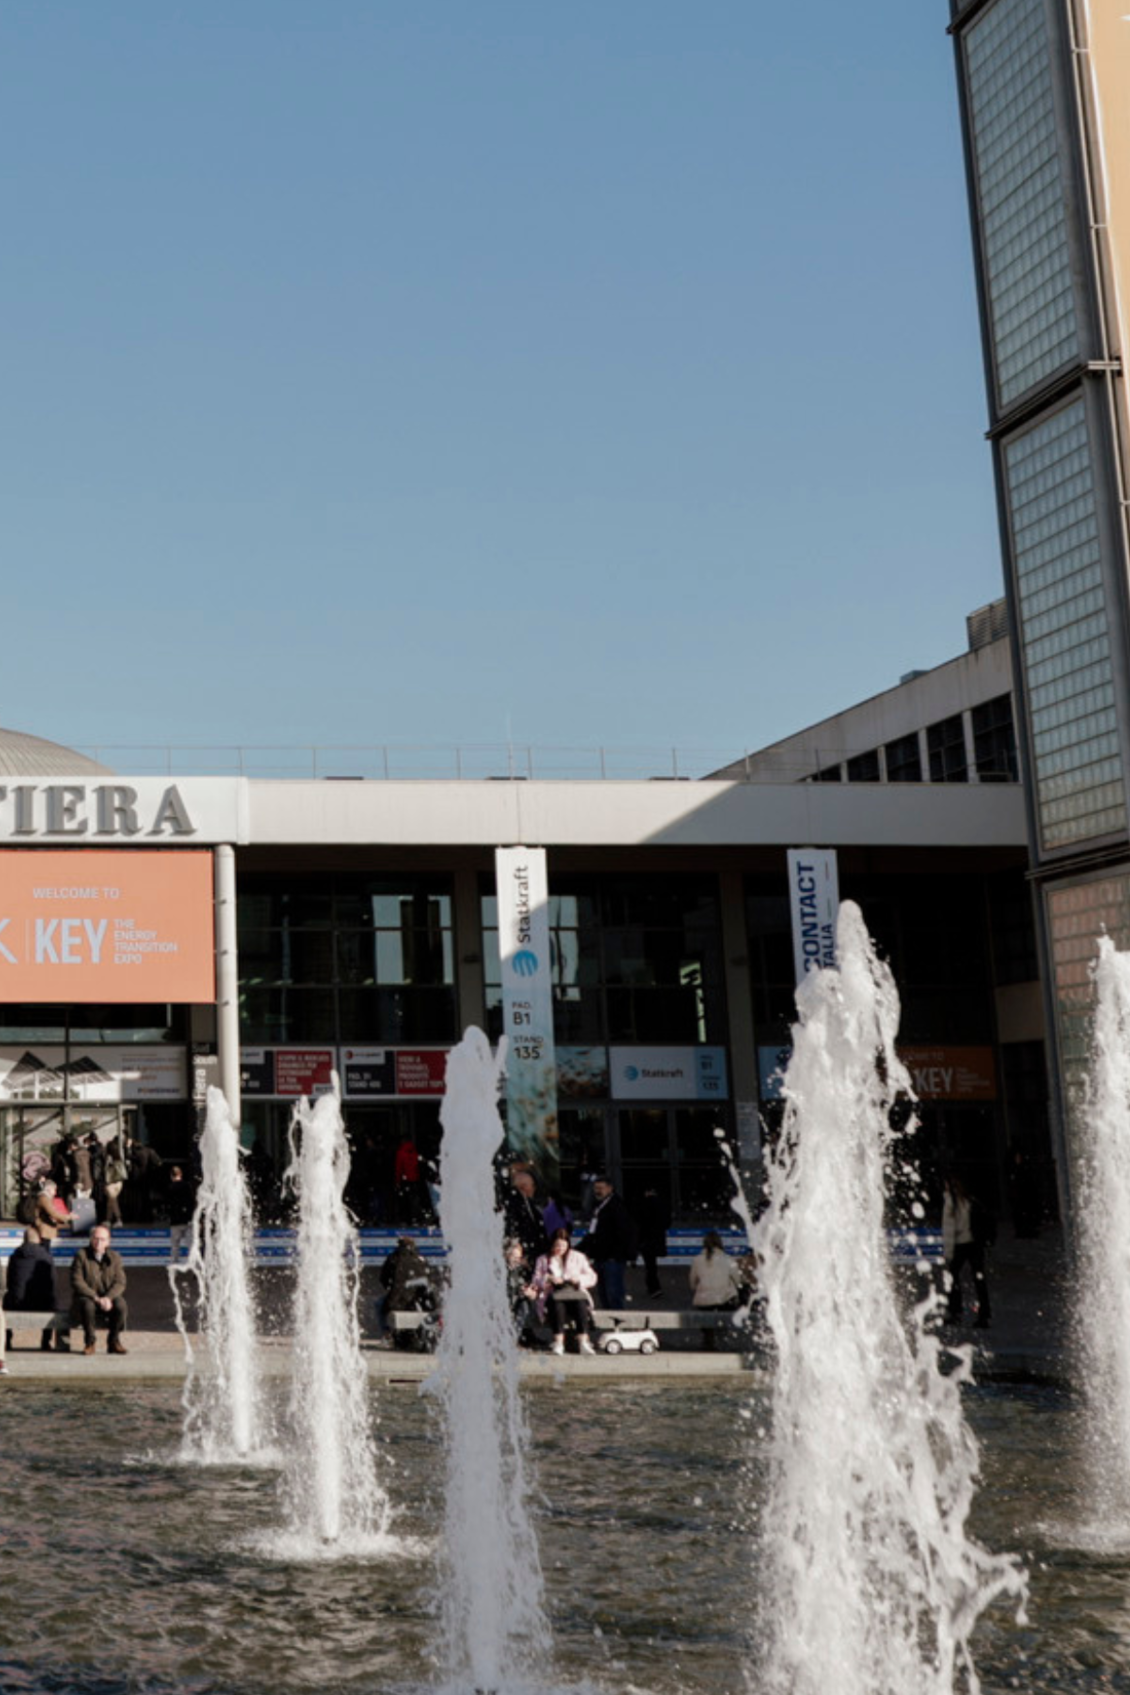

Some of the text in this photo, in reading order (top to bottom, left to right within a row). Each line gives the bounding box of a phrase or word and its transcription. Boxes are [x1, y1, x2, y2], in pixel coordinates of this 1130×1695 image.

[32, 887, 120, 899] WELCOME TO
[514, 865, 531, 943] Statkraft
[114, 918, 135, 929] THE
[35, 917, 109, 964] KEY
[114, 930, 157, 941] ENERGY
[114, 942, 178, 952] TRANSITION
[114, 953, 142, 964] EXPO
[513, 1012, 531, 1026] B1
[513, 1035, 544, 1044] STAND
[513, 1046, 541, 1060] 135
[641, 1068, 683, 1079] Statkraft
[914, 1068, 953, 1093] KEY
